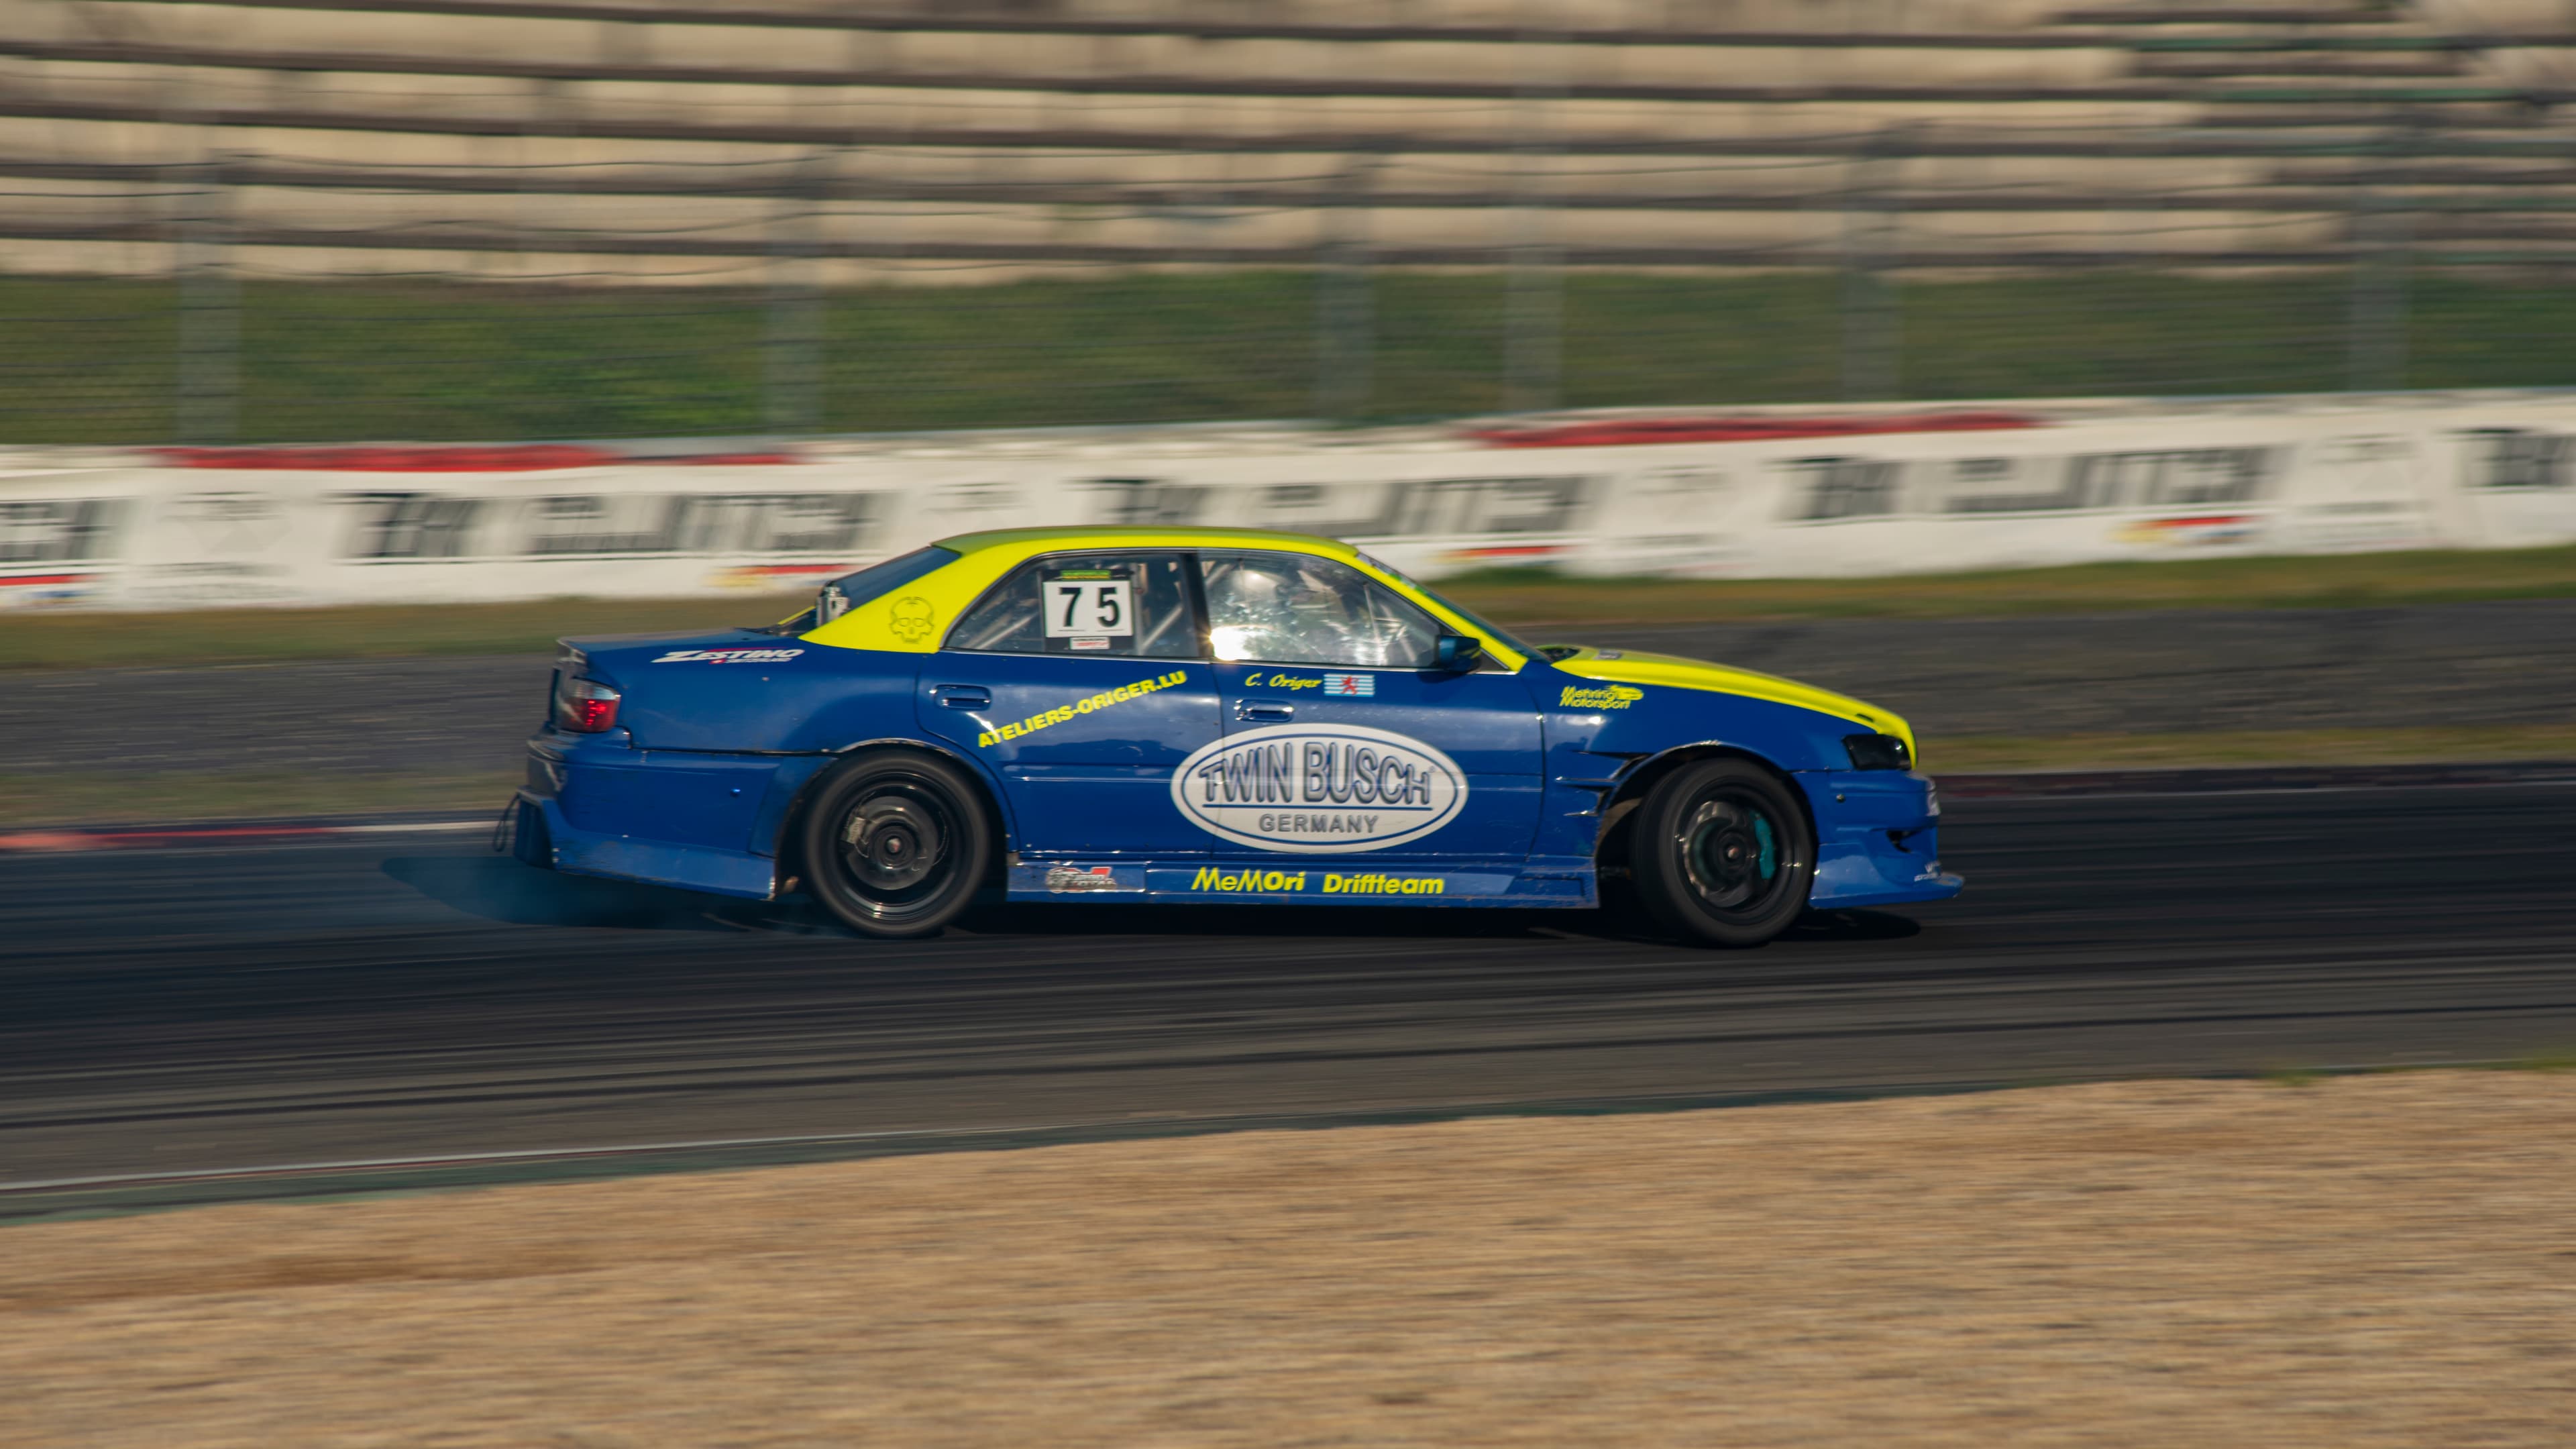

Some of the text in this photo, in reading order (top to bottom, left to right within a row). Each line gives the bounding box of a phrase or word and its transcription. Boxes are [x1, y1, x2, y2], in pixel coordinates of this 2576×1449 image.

[1059, 586, 1121, 628] 75
[1245, 672, 1322, 691] C. Origer
[978, 670, 1187, 747] ATELIERS-ORIGER.LU
[1559, 696, 1631, 710] Motorsport
[1199, 741, 1431, 805] TWIN BUSCH
[1259, 813, 1379, 833] GERMANY
[1191, 867, 1445, 894] MeMOri Driftteam
